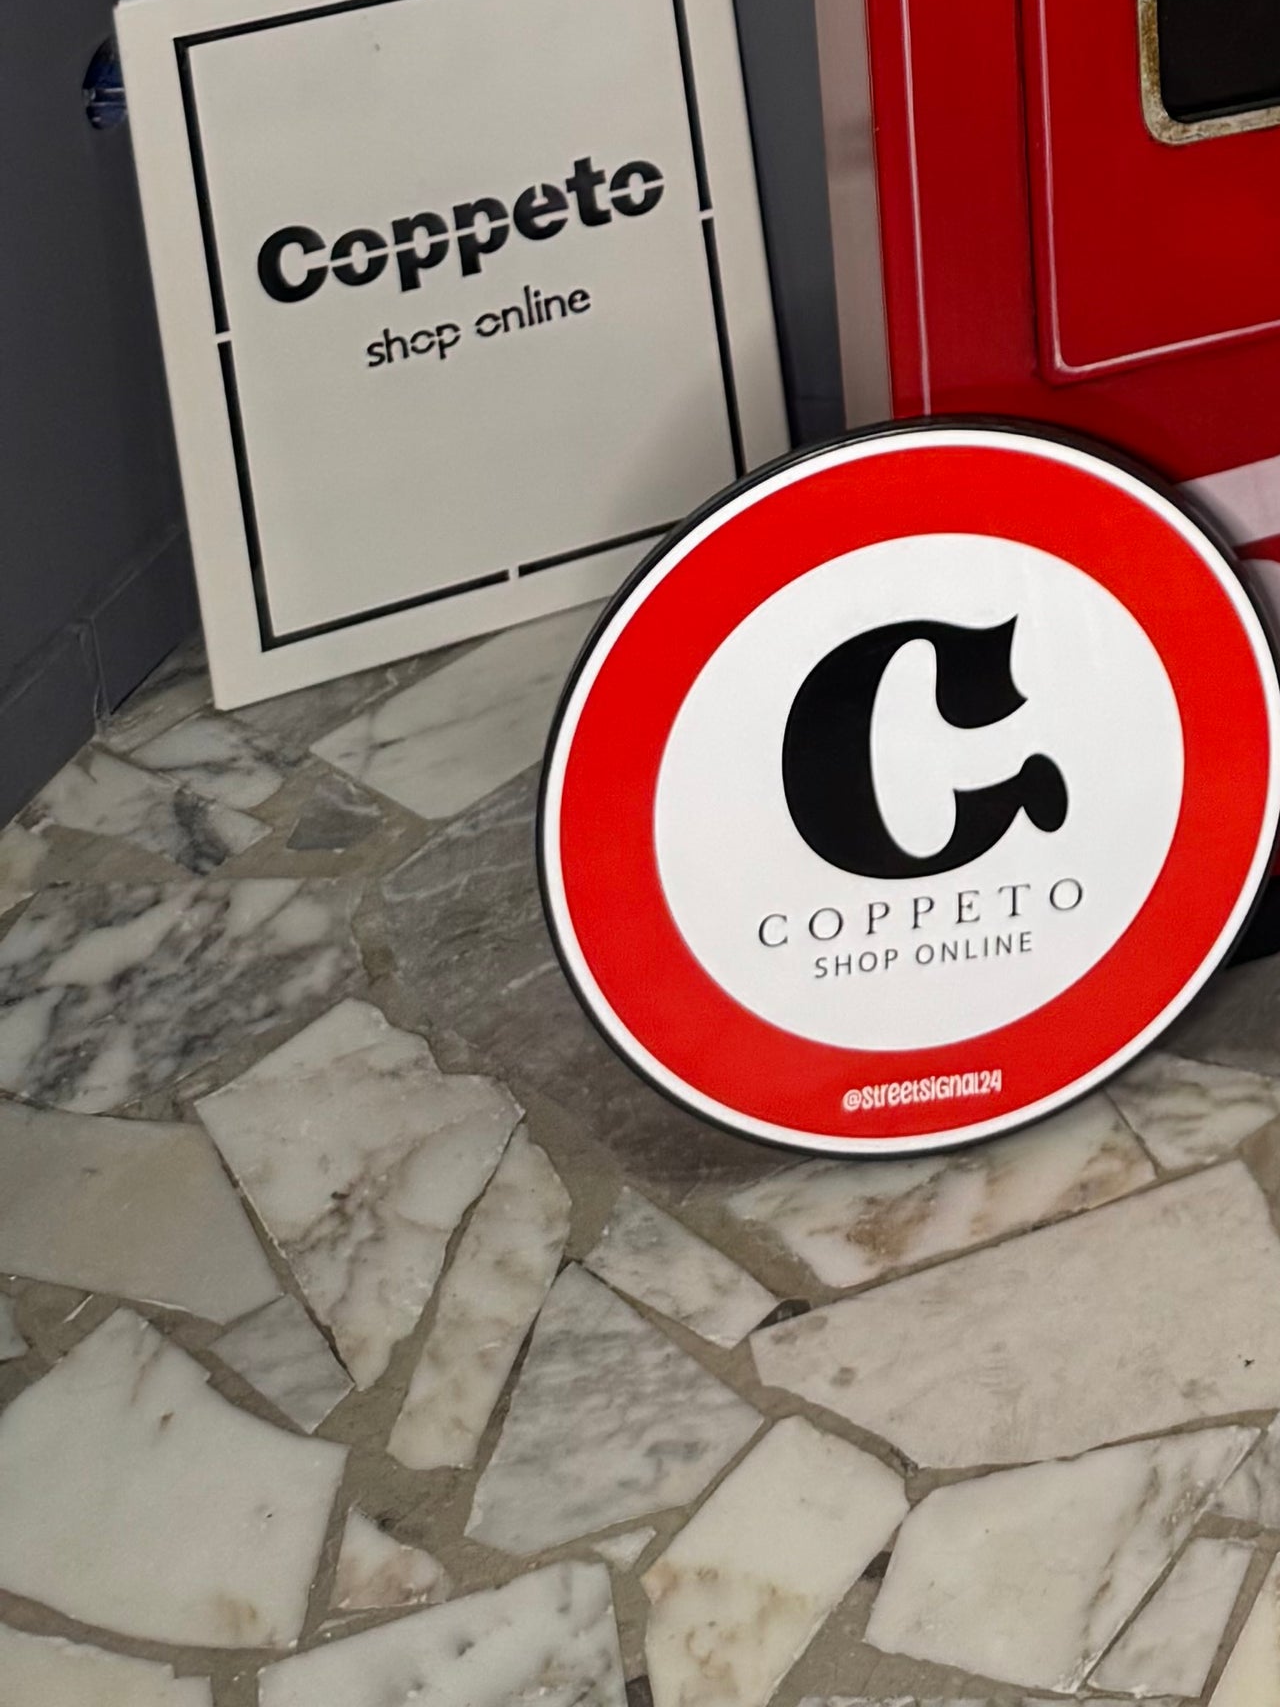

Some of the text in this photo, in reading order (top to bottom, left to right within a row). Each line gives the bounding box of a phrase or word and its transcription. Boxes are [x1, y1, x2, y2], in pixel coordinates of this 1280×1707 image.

[257, 157, 665, 303] Coppeto
[366, 284, 592, 369] shop online
[781, 615, 1069, 880] C
[757, 877, 1084, 948] COPPETO
[814, 930, 1033, 979] SHOP ONLINE
